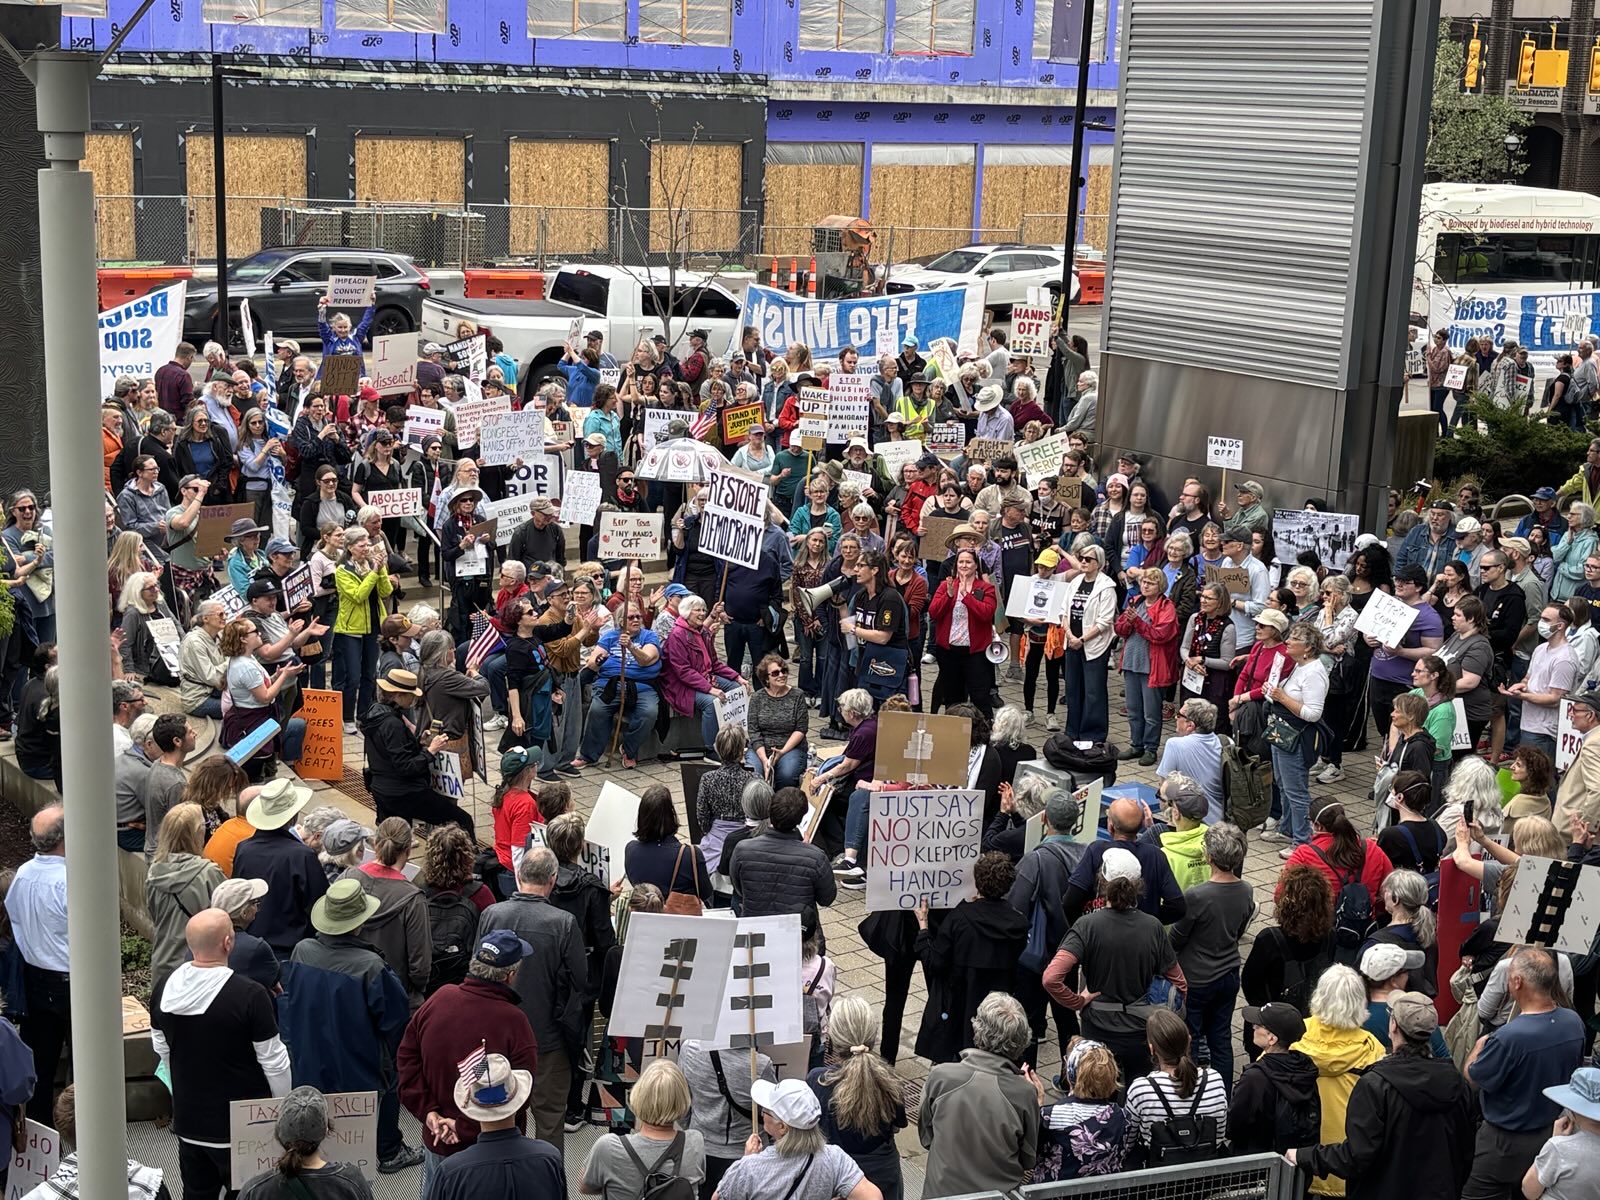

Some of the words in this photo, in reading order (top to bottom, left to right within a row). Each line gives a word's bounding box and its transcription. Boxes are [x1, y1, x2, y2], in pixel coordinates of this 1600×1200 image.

[1448, 219, 1478, 231] Powered
[1480, 219, 1489, 231] by
[1490, 219, 1521, 229] biodiesel
[1522, 219, 1534, 229] and
[1535, 220, 1556, 231] hybrid
[1558, 220, 1594, 232] technology
[1013, 307, 1051, 322] HANDS
[1017, 321, 1042, 336] OFF
[1012, 339, 1048, 356] USA!
[372, 365, 414, 389] dissent!
[801, 390, 829, 401] WAKE
[456, 401, 489, 412] Resistance
[727, 410, 750, 421] STAND
[751, 407, 761, 417] UP
[801, 403, 819, 413] UP
[829, 404, 868, 412] REUNITE
[424, 417, 441, 426] ARE
[482, 413, 503, 428] STOP
[513, 410, 543, 424] TARIFFS
[648, 410, 674, 421] ONLY
[481, 425, 520, 440] CONGRESS
[800, 429, 826, 438] RESIST
[829, 423, 867, 431] FAMILIES
[932, 434, 958, 443] OFF!
[977, 441, 1009, 450] FIGHT
[1208, 438, 1241, 449] HANDS
[1019, 440, 1064, 465] FREE
[1213, 449, 1236, 458] OFF!
[371, 492, 419, 504] ABOLISH
[710, 472, 766, 518] RESTORE
[382, 501, 418, 516] ICE!
[497, 504, 528, 518] DEFEND
[508, 515, 523, 524] THE
[609, 529, 629, 538] TINY
[632, 530, 653, 538] HANDS
[700, 511, 764, 565] DEMOCRACY
[621, 538, 641, 549] OFF
[1218, 572, 1249, 588] STRONG
[722, 706, 746, 723] CONVICT
[310, 733, 337, 743] MAKE
[443, 777, 464, 798] FDA
[879, 795, 934, 818] JUST
[935, 794, 980, 818] SAY
[871, 818, 911, 842] NO
[916, 818, 981, 841] KINGS
[871, 844, 911, 868] NO
[914, 843, 979, 864] KLEPTOS
[889, 869, 963, 892] HANDS
[898, 891, 950, 910] OFF!
[333, 1096, 376, 1115] RICH
[336, 1130, 365, 1145] NIH
[237, 1140, 265, 1156] EPA
